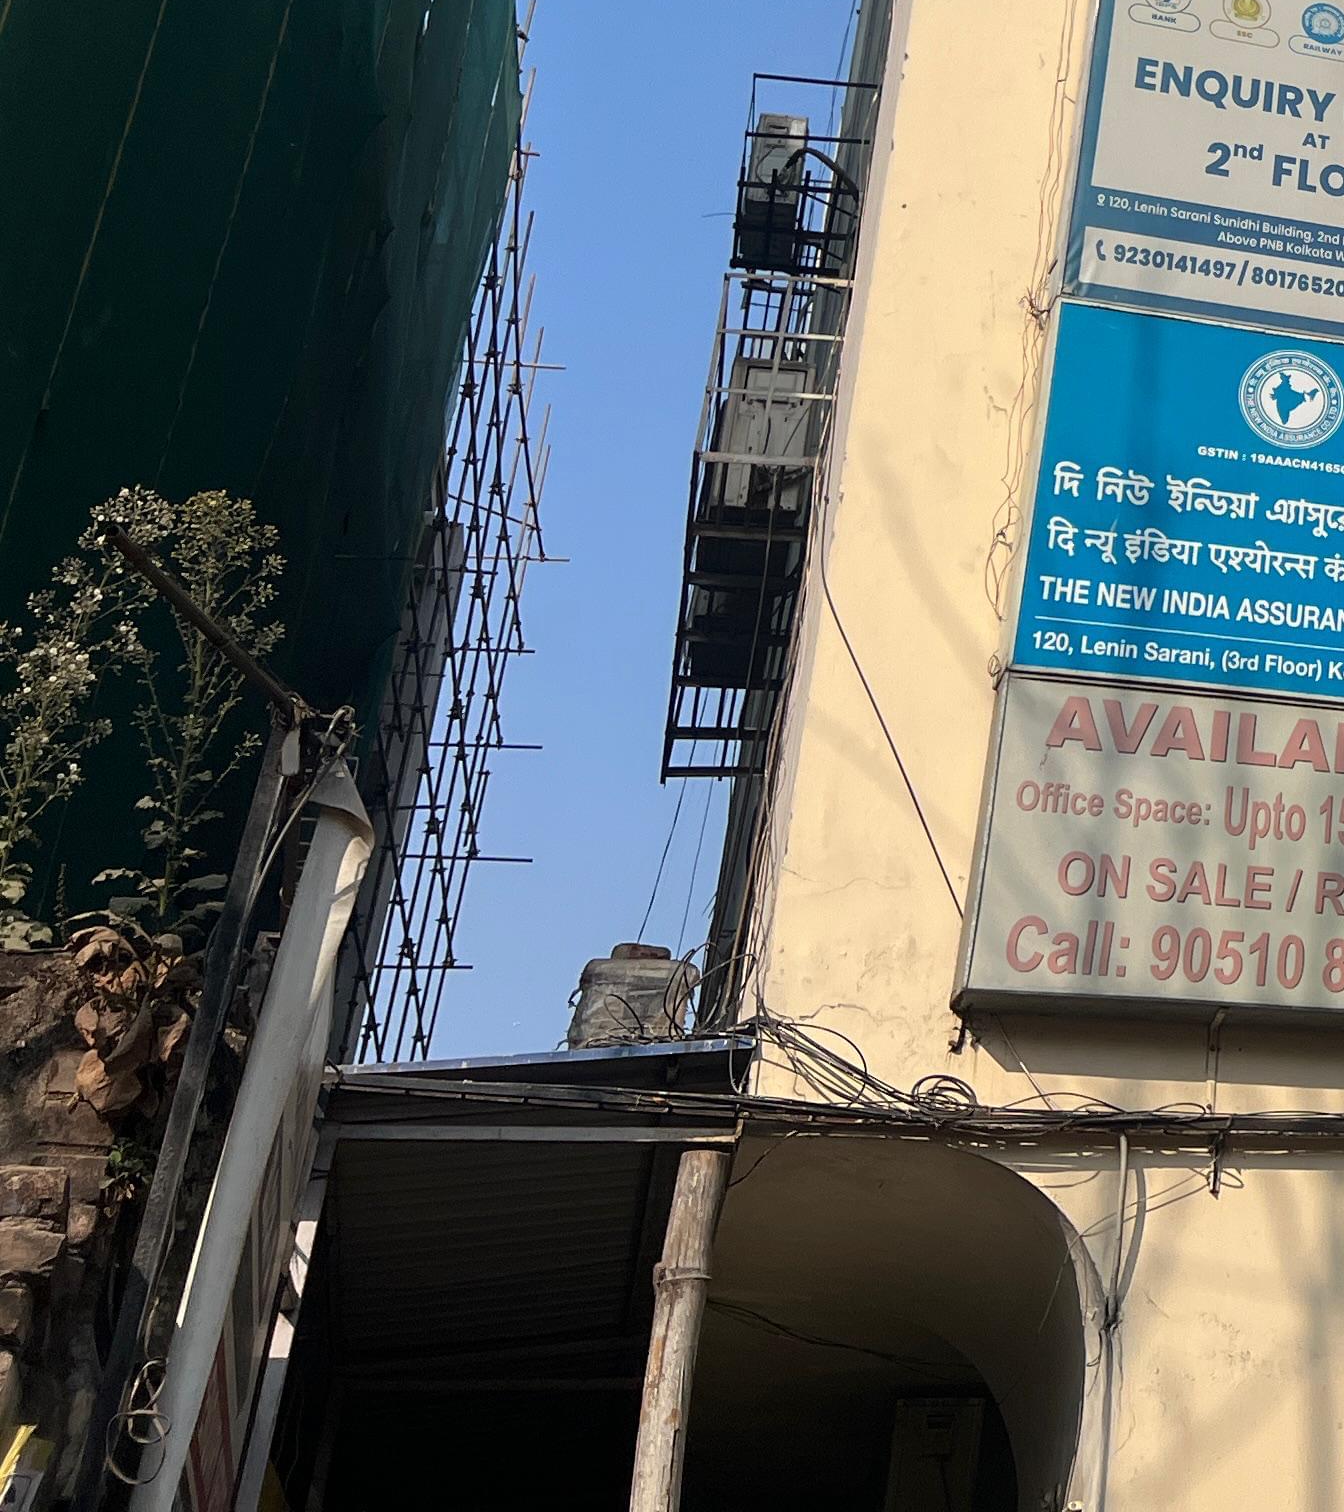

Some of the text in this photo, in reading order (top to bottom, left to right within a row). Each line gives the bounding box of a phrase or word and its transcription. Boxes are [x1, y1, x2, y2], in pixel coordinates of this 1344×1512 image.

[1303, 43, 1344, 57] RAILWAY
[1134, 56, 1338, 123] ENQUIRY
[1203, 140, 1265, 178] 2nd
[1301, 131, 1331, 151] AT
[1109, 195, 1132, 212] 120,
[1134, 199, 1168, 217] Lenin
[1170, 206, 1212, 224] Sarani
[1213, 212, 1261, 232] Sunidhi
[1262, 221, 1315, 244] Building,
[1317, 230, 1340, 245] 2nd
[1113, 243, 1237, 281] 9230141497
[1217, 230, 1258, 248] Above
[1259, 237, 1284, 252] PNB
[1286, 243, 1333, 261] Kolkata
[1197, 445, 1239, 461] GSTIN
[1053, 460, 1085, 499] দি
[1095, 465, 1155, 506] নিউ
[1166, 473, 1261, 521] ইন্ডিয়া
[1046, 515, 1079, 558] दि
[1084, 528, 1119, 566] न्यू
[1123, 527, 1203, 567] इंडिया
[1207, 539, 1319, 581] एश्योरन्स
[1039, 574, 1092, 605] THE
[1096, 581, 1157, 612] NEW
[1161, 588, 1230, 621] INDIA
[1032, 629, 1074, 657] 120,
[1080, 634, 1139, 660] Lenin
[1143, 641, 1216, 672] Sarani,
[1221, 649, 1259, 673] (3rd
[1264, 653, 1323, 683] Floor)
[1015, 779, 1106, 818] Office
[1113, 788, 1213, 829] Space:
[1223, 785, 1307, 851] Upto
[1057, 850, 1131, 899] ON
[1145, 857, 1275, 912] SALE
[1004, 914, 1132, 979] Call:
[1149, 924, 1305, 990] 90510
